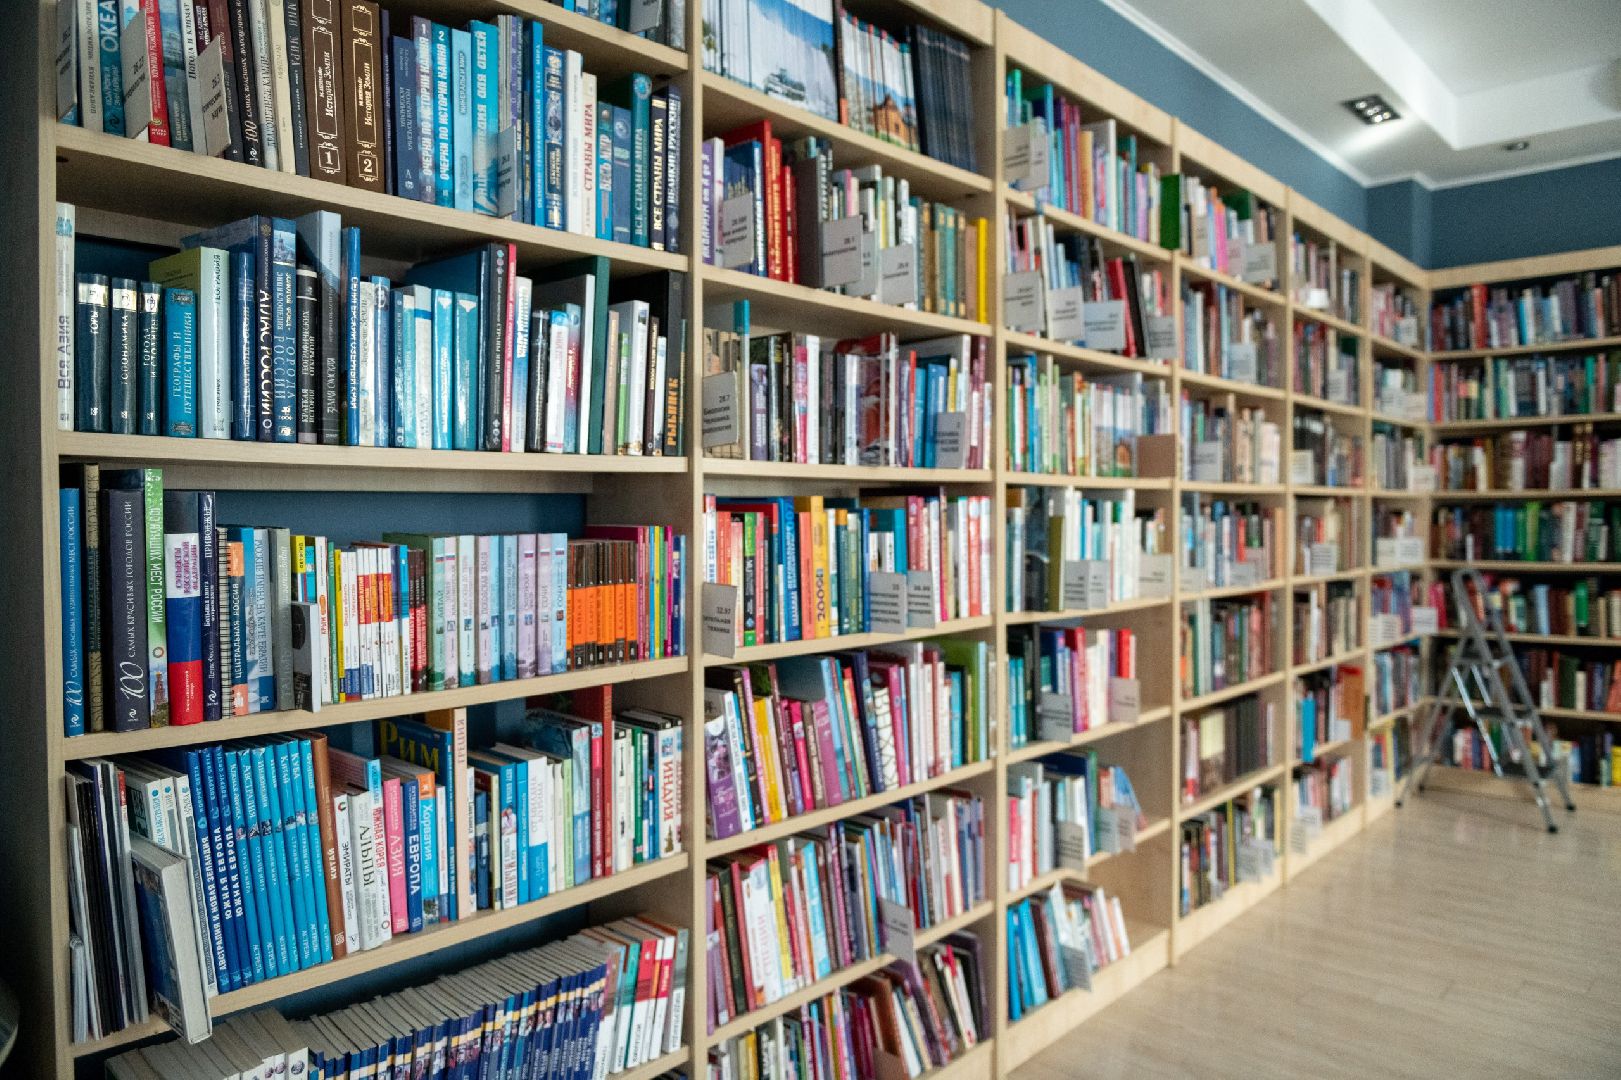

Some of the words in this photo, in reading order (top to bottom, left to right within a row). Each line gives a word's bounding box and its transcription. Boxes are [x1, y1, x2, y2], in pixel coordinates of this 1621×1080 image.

[438, 30, 445, 41] 2
[475, 31, 487, 70] ДЕТЕЙ
[324, 51, 332, 78] Земли
[419, 37, 430, 73] КАМНЯ
[437, 43, 447, 79] КАМНЯ
[363, 62, 371, 89] Земли
[325, 80, 334, 118] История
[365, 90, 373, 126] История
[420, 74, 431, 120] ИСТОРИИ
[437, 81, 448, 125] ИСТОРИИ
[244, 120, 259, 144] 100
[421, 121, 432, 135] ПО
[438, 127, 449, 140] ПО
[584, 103, 593, 138] МИРА
[653, 118, 663, 153] МИРА
[325, 151, 334, 165] 1
[421, 137, 433, 176] ОЧЕРКИ
[439, 142, 450, 180] ОЧЕРКИ
[599, 134, 611, 161] МИР
[634, 128, 643, 161] МИРА
[363, 158, 373, 172] 2
[584, 141, 593, 192] СТРАНЫ
[599, 162, 612, 192] ВЕСЬ
[653, 155, 663, 206] СТРАНЫ
[634, 164, 643, 211] СТРАНЫ
[634, 214, 643, 236] ВСЕ
[653, 208, 663, 231] ВСЕ
[90, 310, 99, 335] ГОРЫ
[260, 289, 272, 343] АТЛАС
[57, 315, 72, 357] Азия
[120, 315, 129, 386] ТОПОНИМИКА
[142, 327, 151, 366] ГОРОДА
[172, 331, 181, 340] И
[301, 310, 310, 375] ГЕОГРАФИЧЕСКИХ
[57, 360, 72, 390] Вся
[172, 343, 182, 398] ГЕОГРАФЫ
[182, 311, 192, 414] ПУТЕШЕСТВЕННИКИ
[260, 346, 272, 415] РОССИИ
[274, 335, 286, 400] РОССИИ
[286, 336, 296, 399] ГОРОДА
[301, 388, 310, 423] КРАТКАЯ
[67, 506, 75, 540] РОССИИ
[124, 501, 133, 537] РОССИИ
[68, 539, 76, 563] МЕСТ
[125, 538, 134, 578] ГОРОДОВ
[174, 547, 182, 589] СУБЪЕКТЫ
[182, 541, 190, 594] РОССИЙСКОЙ
[191, 544, 199, 591] ФЕДЕРАЦИИ
[150, 563, 162, 586] МЕСТ
[126, 580, 136, 625] КРАСИВЫХ
[150, 588, 163, 623] РОССИИ
[232, 583, 241, 616] РОССИЯ
[127, 627, 136, 658] САМЫХ
[258, 616, 266, 640] КАРТЕ
[69, 648, 78, 678] САМЫХ
[234, 620, 242, 679] ЦЕНТРАЛЬНАЯ
[259, 641, 268, 673] ЕВРАЗИИ
[65, 680, 83, 707] 100
[119, 661, 145, 701] 100
[457, 718, 465, 764] ГРЕЦИЯ
[243, 764, 256, 818] АВСТРАЛИЯ
[662, 760, 673, 821] ИНДИЯ
[372, 807, 384, 840] ЮЖНАЯ
[422, 804, 435, 861] Хорватия
[201, 836, 215, 883] ЗЕЛАНДИЯ
[213, 826, 228, 873] ЕВРОПА
[225, 825, 239, 871] ЕВРОПА
[290, 752, 300, 779] КУБА
[310, 923, 319, 952] АСТРЕЛЬ
[328, 847, 338, 880] КИТАЙ
[341, 841, 353, 886] ЭМИРАТЫ
[359, 825, 375, 887] АЛЬПЫ
[375, 841, 386, 868] КОРЕЯ
[389, 835, 403, 877] АЗИЯ
[408, 834, 420, 896] ЕВРОПА
[206, 885, 218, 912] НОВАЯ
[219, 876, 233, 920] ЮЖНАЯ
[231, 874, 245, 918] ЮЖНАЯ
[212, 922, 228, 971] АВСТРАЛИЯ
[253, 944, 262, 974] АСТРЕЛЬ
